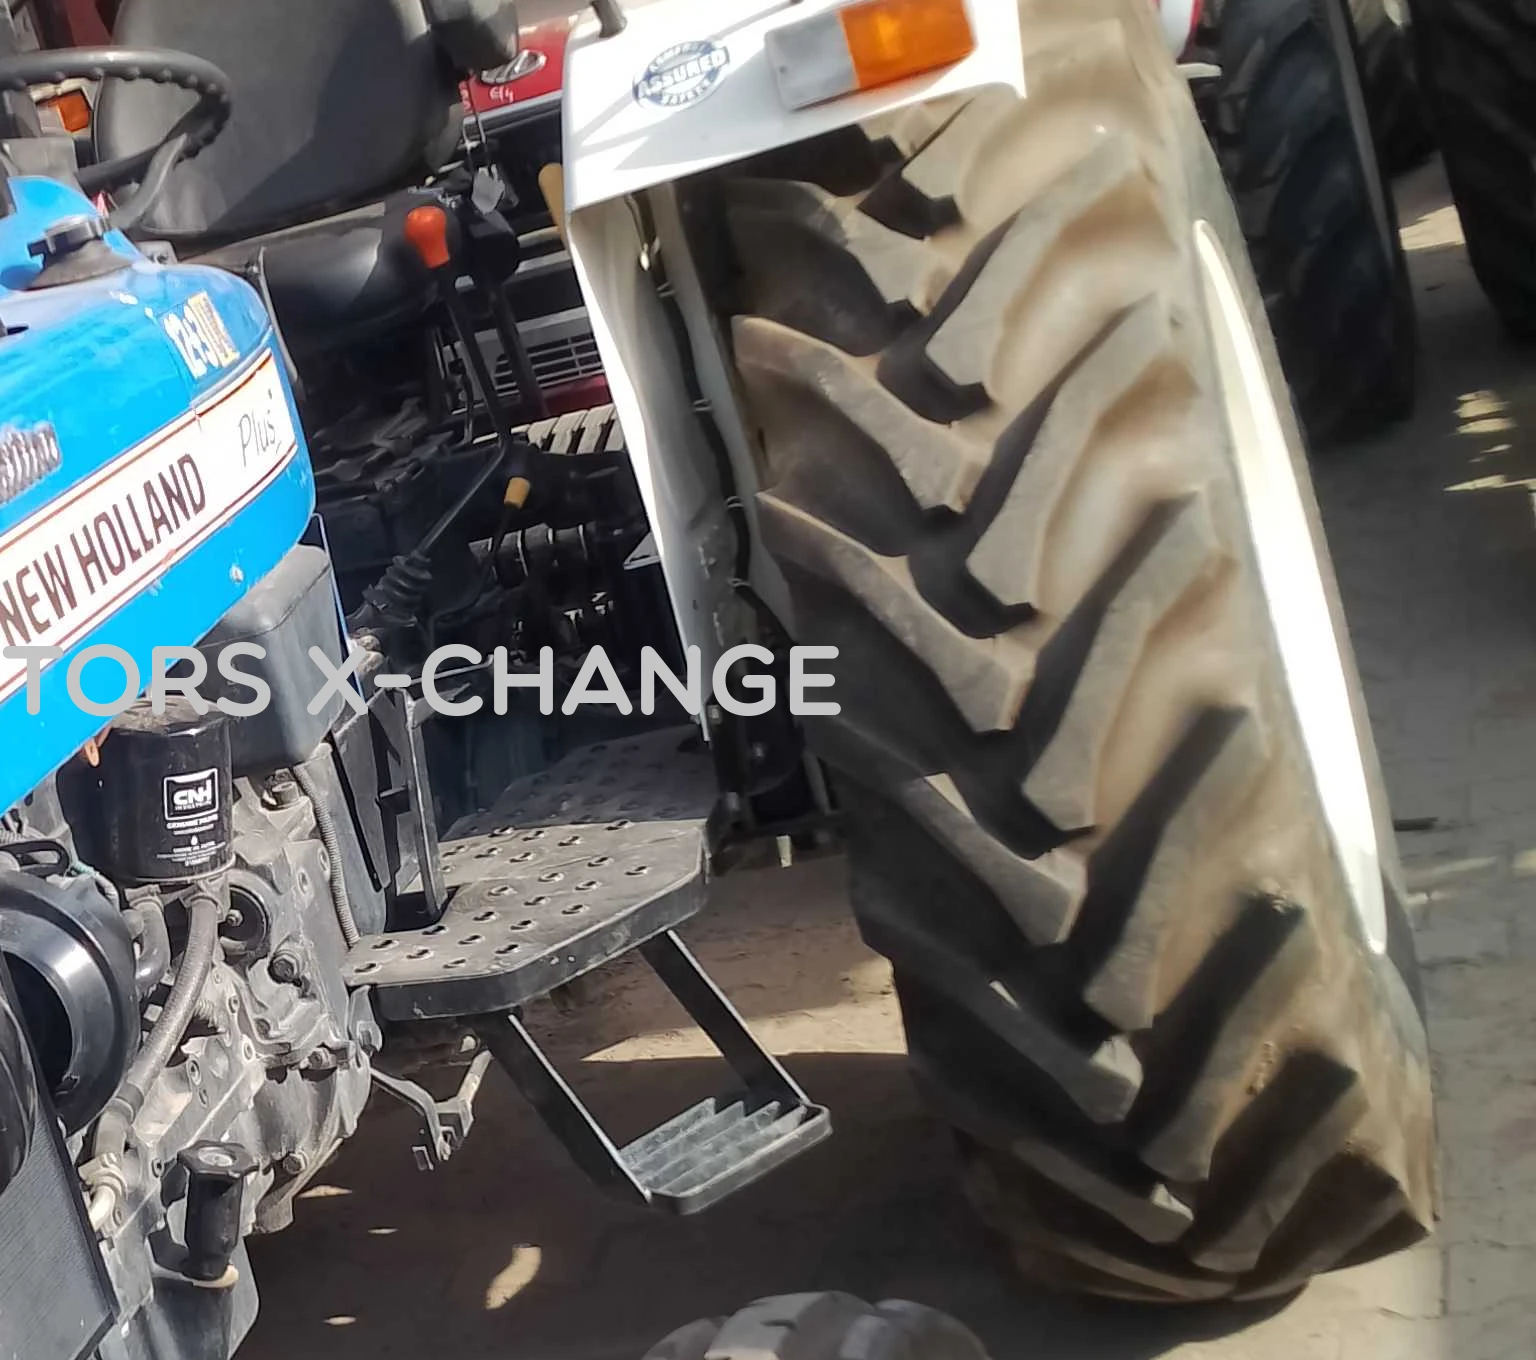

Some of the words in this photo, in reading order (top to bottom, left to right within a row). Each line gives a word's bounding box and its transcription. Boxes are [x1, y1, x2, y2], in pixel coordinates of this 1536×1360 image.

[638, 48, 726, 97] ASSURED
[70, 453, 206, 595] HOLLAND
[173, 778, 213, 806] CNH
